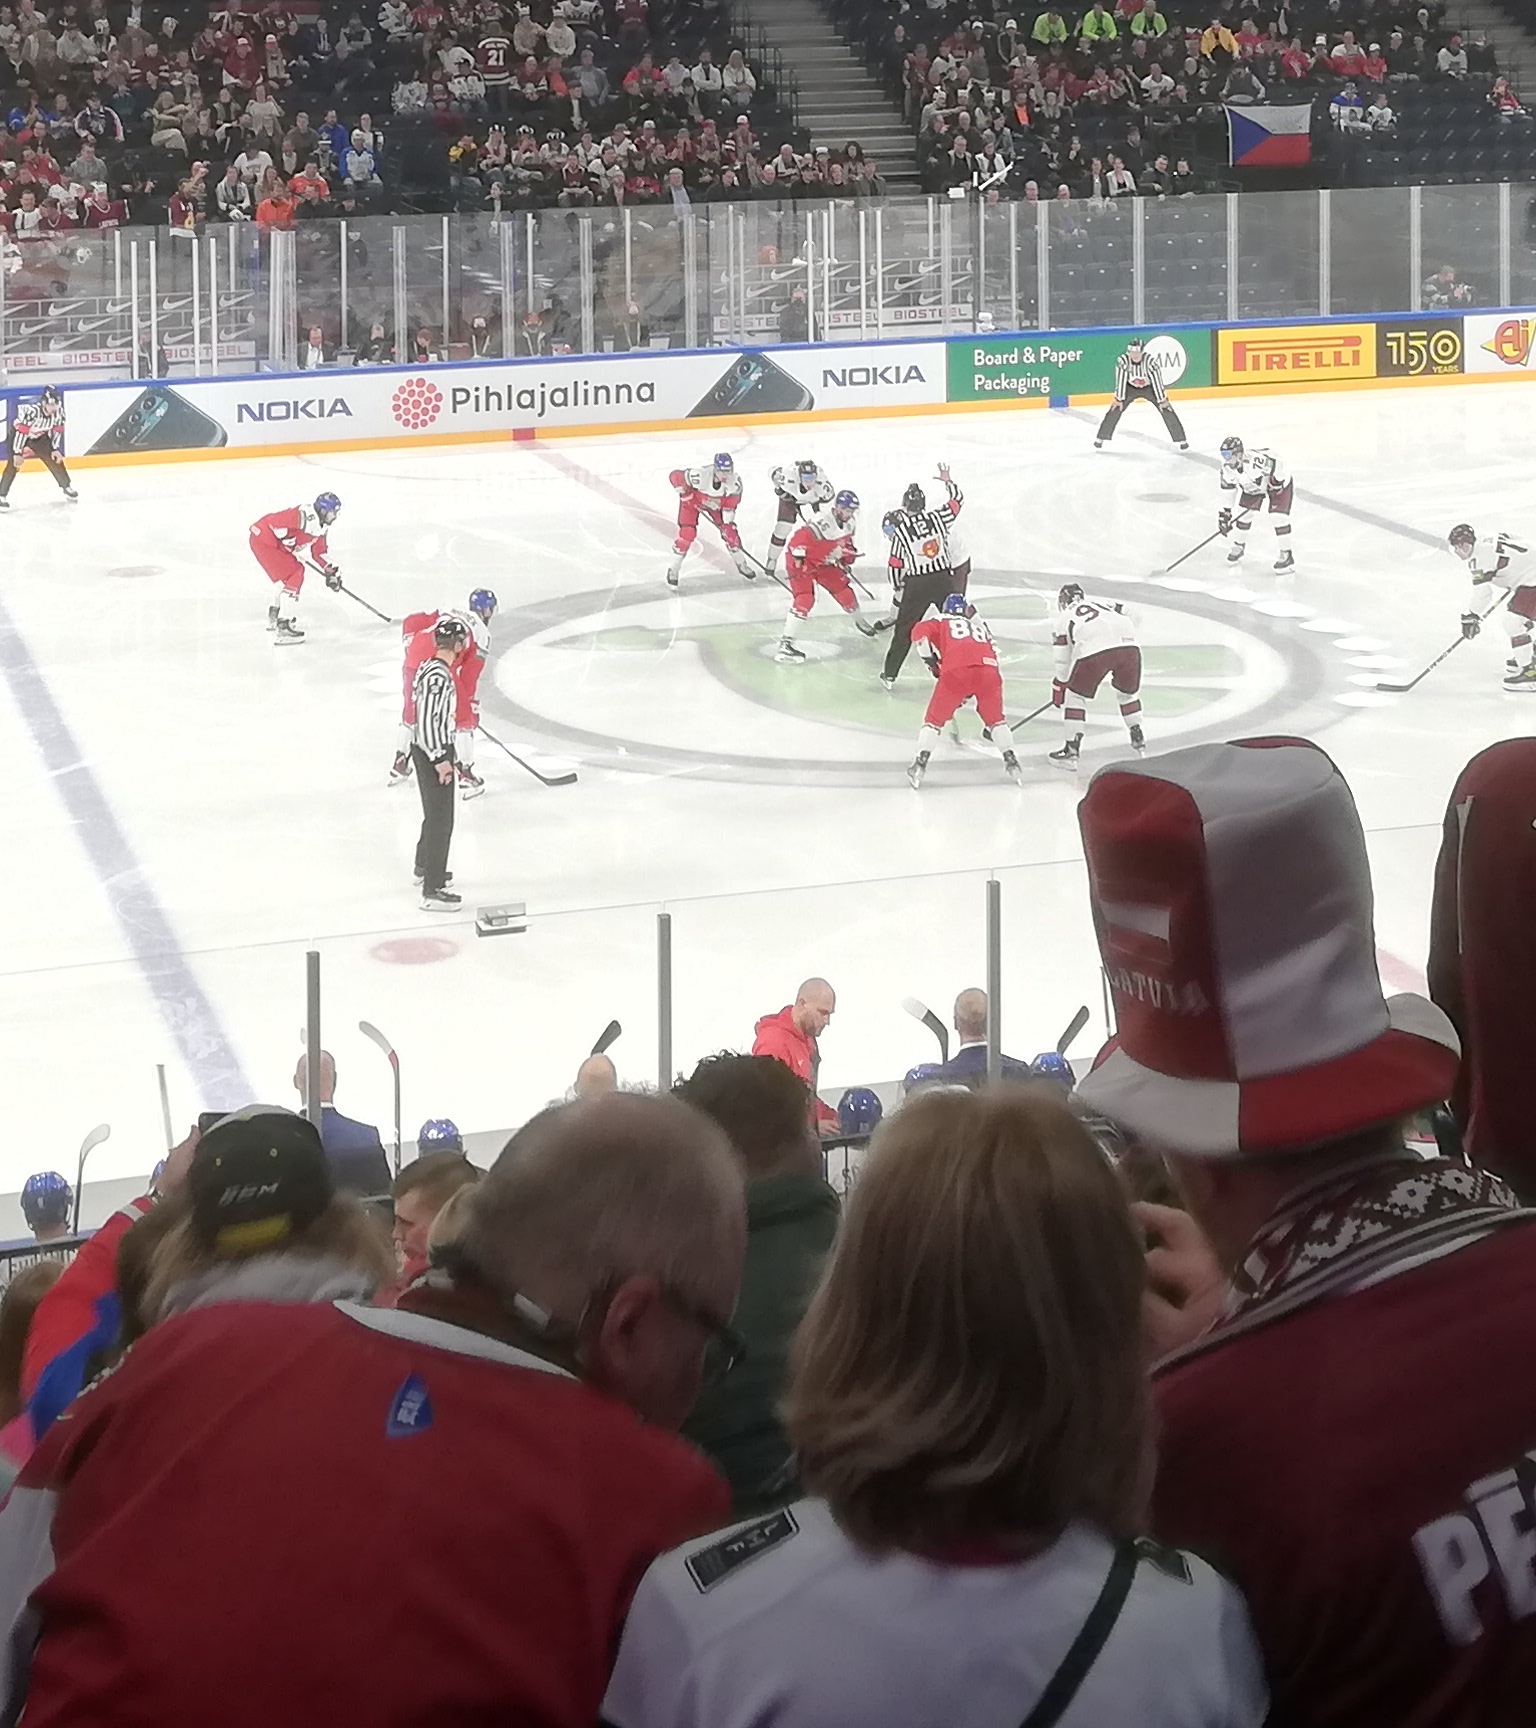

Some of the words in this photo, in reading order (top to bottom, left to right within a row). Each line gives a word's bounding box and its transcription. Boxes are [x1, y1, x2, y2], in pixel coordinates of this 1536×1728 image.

[487, 49, 505, 66] 21
[974, 348, 1018, 366] Board
[1023, 346, 1036, 364] &
[1040, 346, 1083, 368] Paper
[1232, 335, 1362, 373] PIRELLI
[1386, 330, 1461, 375] 150
[822, 362, 926, 389] NOKIA
[1432, 365, 1459, 374] YEARS
[974, 373, 1050, 395] Packaging
[237, 395, 354, 424] NOKIA
[450, 376, 657, 421] Pihlajalinna
